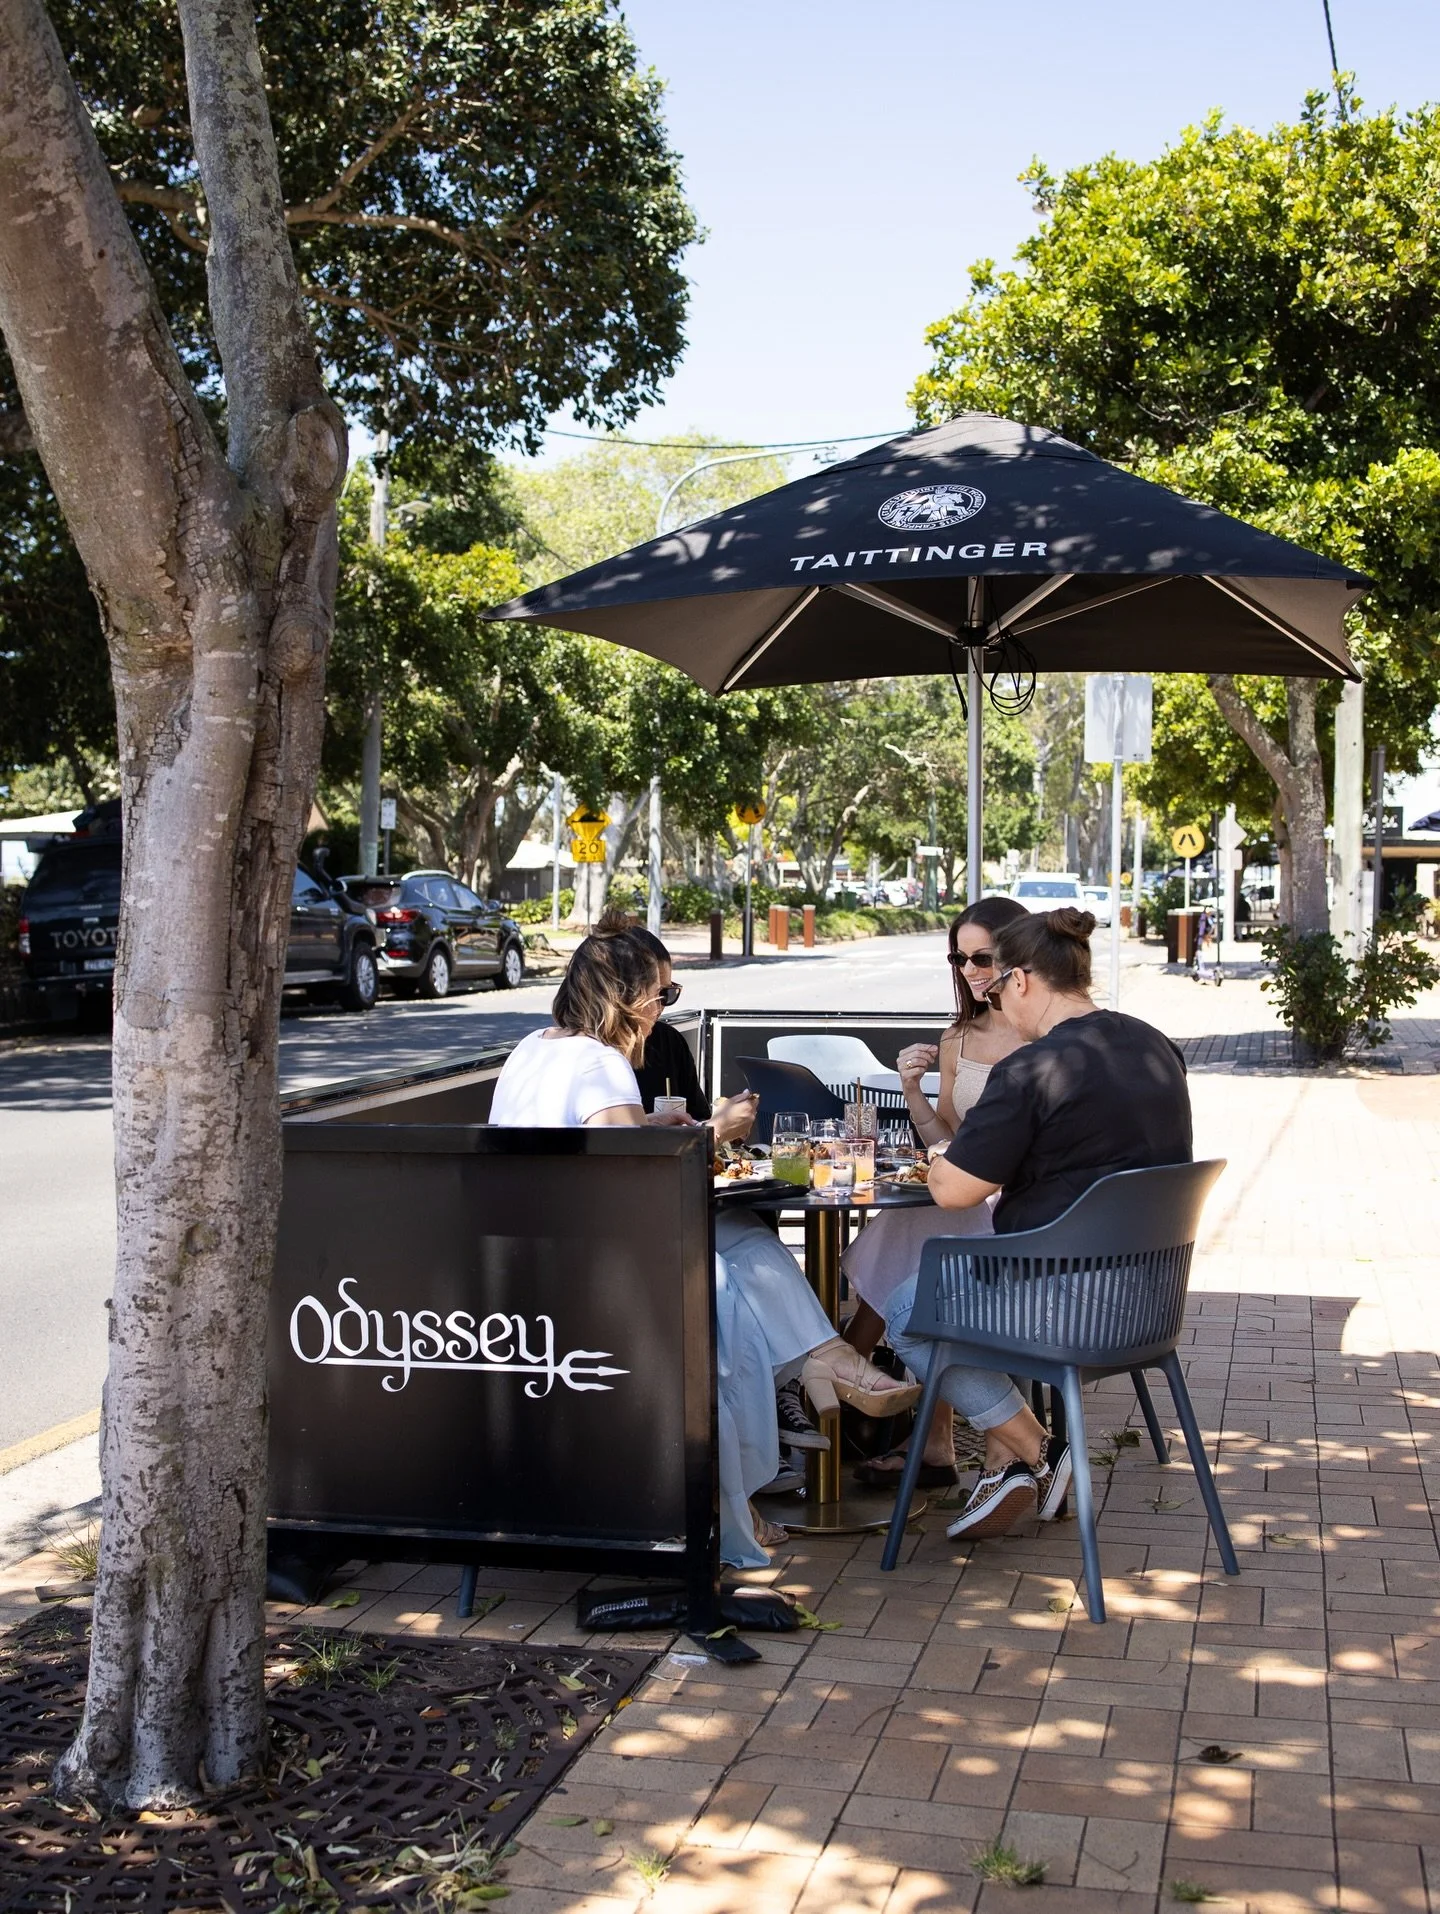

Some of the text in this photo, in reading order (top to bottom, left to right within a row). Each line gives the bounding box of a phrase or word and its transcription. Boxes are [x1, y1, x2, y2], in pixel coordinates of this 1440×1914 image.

[790, 542, 1047, 571] TAITTINGER
[579, 842, 599, 854] 20
[50, 926, 119, 949] TOYOT
[290, 1277, 554, 1398] Odyssey
